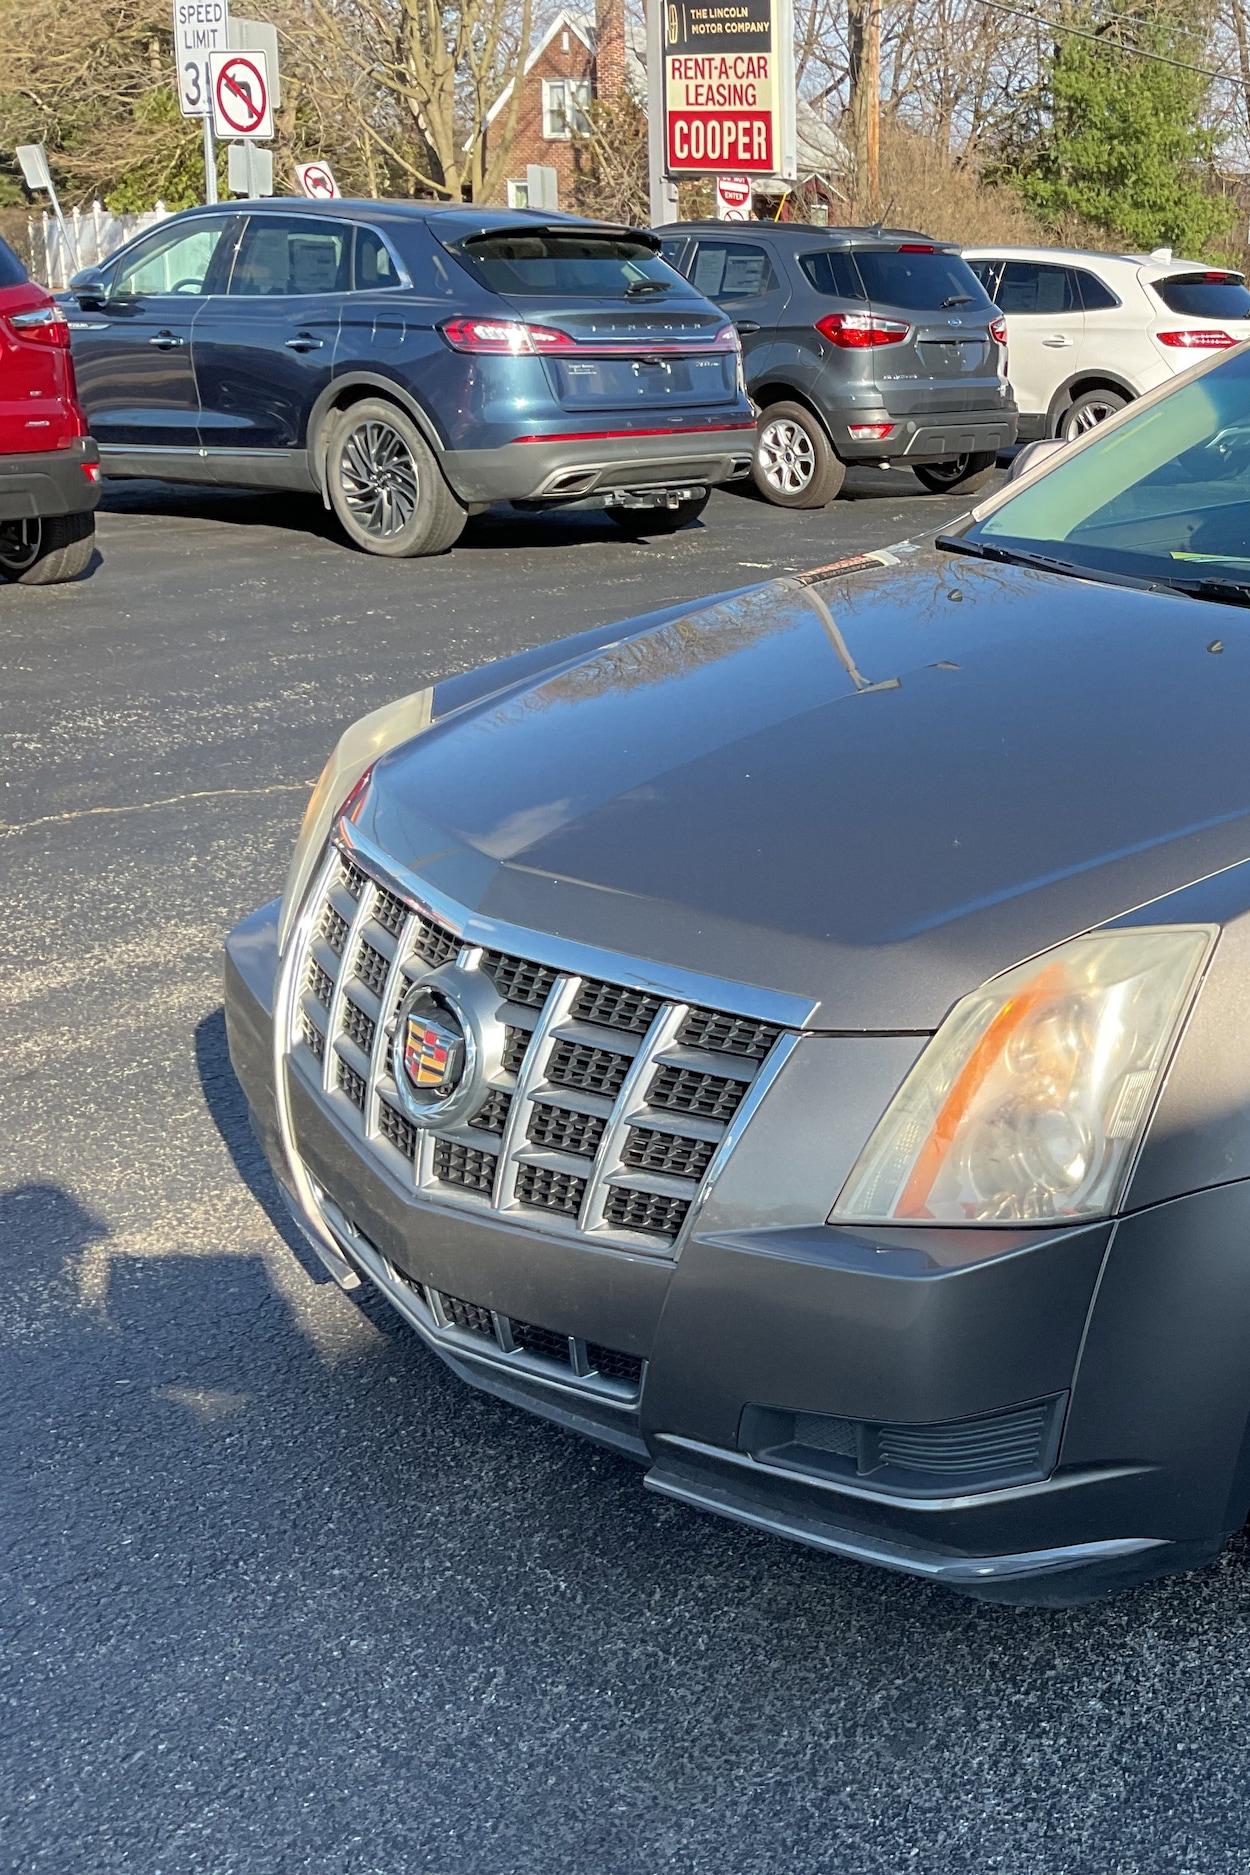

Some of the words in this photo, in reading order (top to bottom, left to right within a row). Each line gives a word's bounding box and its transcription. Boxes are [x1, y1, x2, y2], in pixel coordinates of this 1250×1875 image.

[179, 3, 223, 25] SPEED
[690, 9, 708, 19] THE
[709, 7, 748, 18] LINCOLN
[184, 29, 218, 49] LIMIT
[691, 24, 723, 34] MOTOR
[725, 22, 770, 33] COMPANY
[671, 56, 768, 80] RENT-A-CAR
[184, 61, 210, 106] 3
[685, 83, 757, 107] LEASING
[674, 120, 767, 160] COOPER
[724, 191, 744, 200] ENTER
